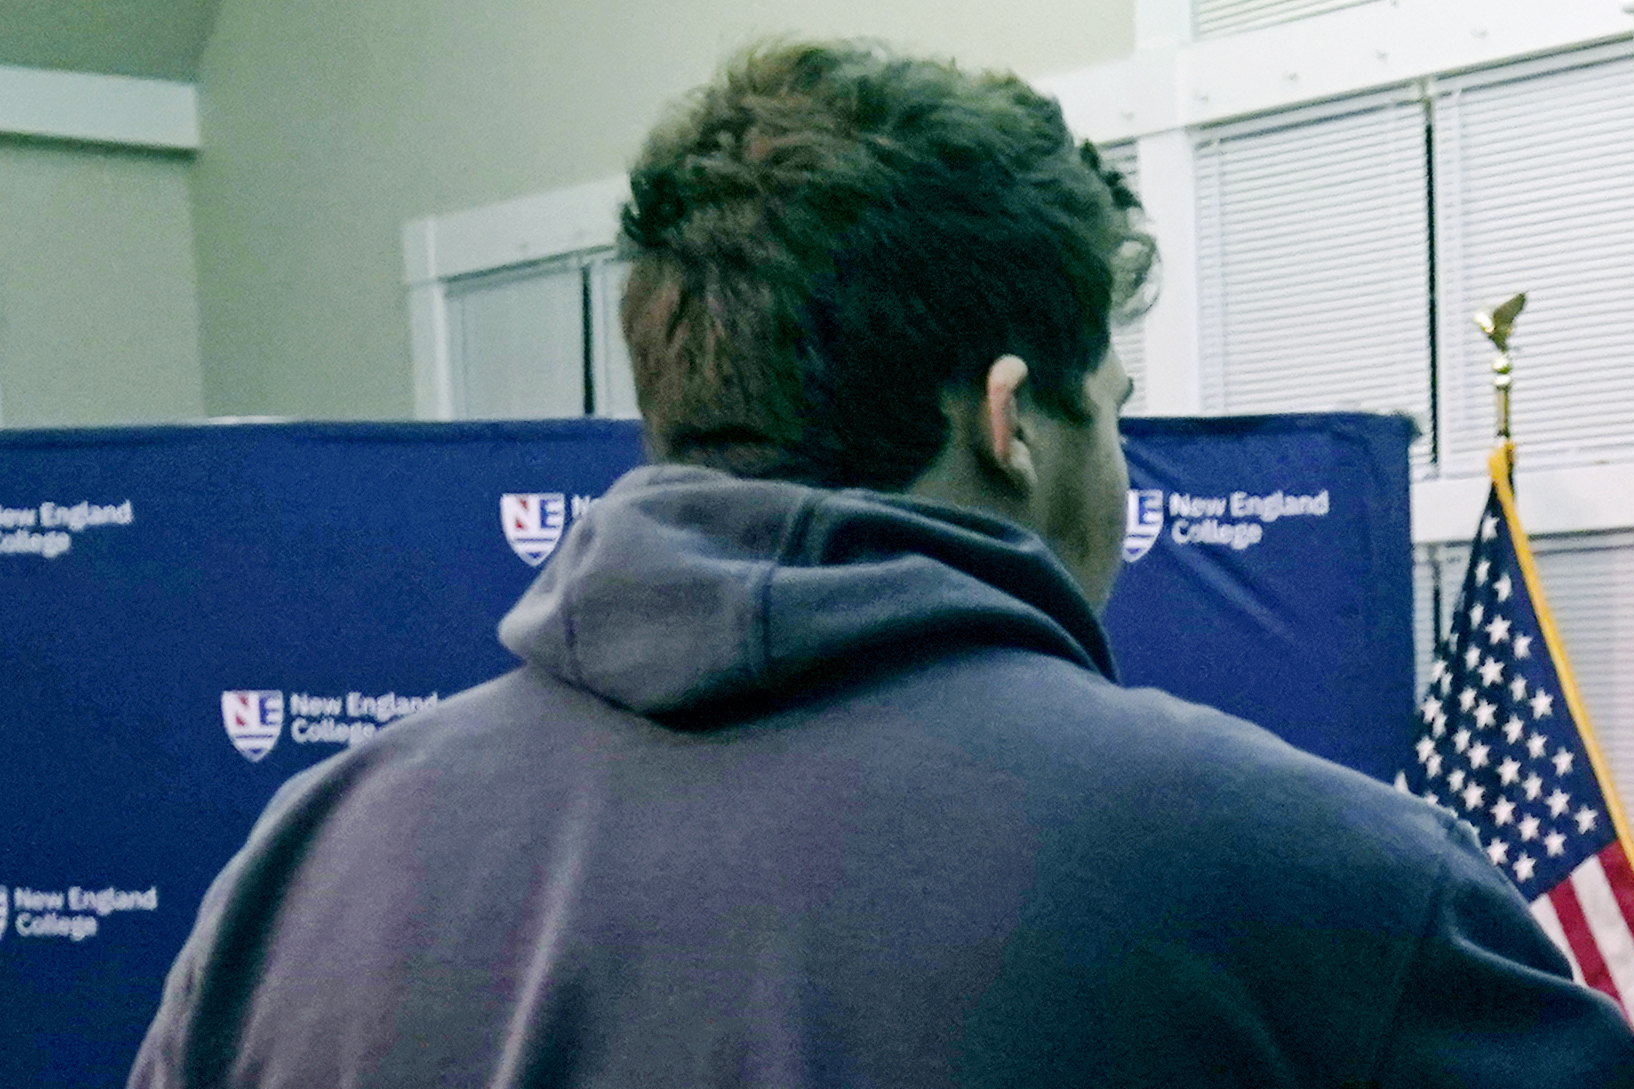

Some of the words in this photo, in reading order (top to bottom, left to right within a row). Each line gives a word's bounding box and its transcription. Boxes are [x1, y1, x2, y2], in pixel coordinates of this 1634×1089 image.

[0, 505, 36, 527] ew
[40, 500, 133, 532] England
[1169, 491, 1226, 517] New
[1230, 488, 1329, 523] England
[0, 529, 70, 558] ollege
[1172, 518, 1263, 551] College
[290, 692, 342, 717] New
[346, 691, 438, 722] England
[14, 886, 64, 911] New
[68, 885, 158, 916] England
[15, 911, 97, 941] College
